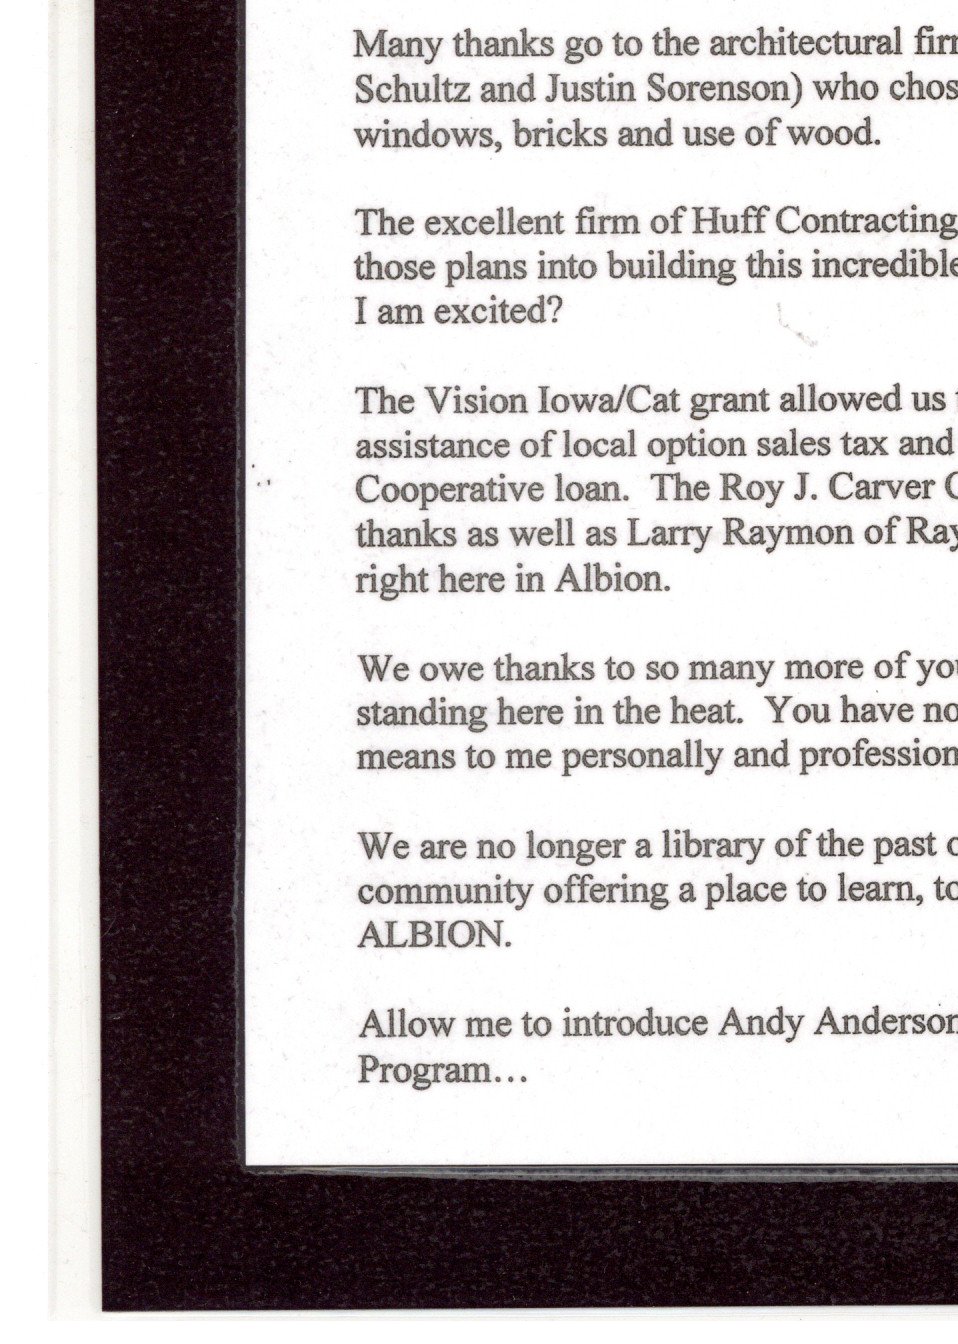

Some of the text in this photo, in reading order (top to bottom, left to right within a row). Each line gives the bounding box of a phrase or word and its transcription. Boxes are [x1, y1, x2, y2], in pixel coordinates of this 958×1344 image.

[353, 30, 443, 64] Many
[453, 28, 554, 57] thanks
[565, 37, 603, 64] go
[612, 32, 642, 56] to
[652, 27, 699, 56] the
[710, 26, 902, 55] architectural
[355, 208, 414, 235] The
[425, 207, 565, 235] excellent
[575, 206, 640, 234] firm
[651, 206, 687, 234] of
[692, 205, 770, 234] Huff
[355, 386, 415, 414] The
[424, 385, 528, 414] Vision
[538, 385, 680, 413] Iowa/Cat
[690, 388, 770, 420] grant
[780, 383, 902, 412] allowed
[911, 392, 946, 411] us
[356, 474, 544, 510] Cooperative
[555, 473, 629, 501] loan.
[651, 472, 710, 501] The
[720, 473, 784, 508] Roy
[794, 472, 817, 500] J.
[829, 472, 935, 500] Carver
[355, 518, 457, 548] thanks
[468, 527, 498, 547] as
[509, 518, 575, 546] well
[586, 527, 617, 546] as
[627, 518, 712, 553] Larry
[723, 518, 854, 554] Raymon
[865, 515, 901, 544] of
[356, 562, 670, 601] right here in Albion.
[357, 749, 456, 769] means
[465, 745, 495, 769] to
[506, 749, 551, 768] me
[562, 739, 723, 776] personally
[734, 738, 790, 768] and
[357, 920, 511, 948] ALBION.
[359, 1008, 456, 1038] Allow
[466, 1017, 512, 1037] me
[521, 1012, 552, 1037] to
[563, 1007, 708, 1036] introduce
[718, 1006, 804, 1043] Andy
